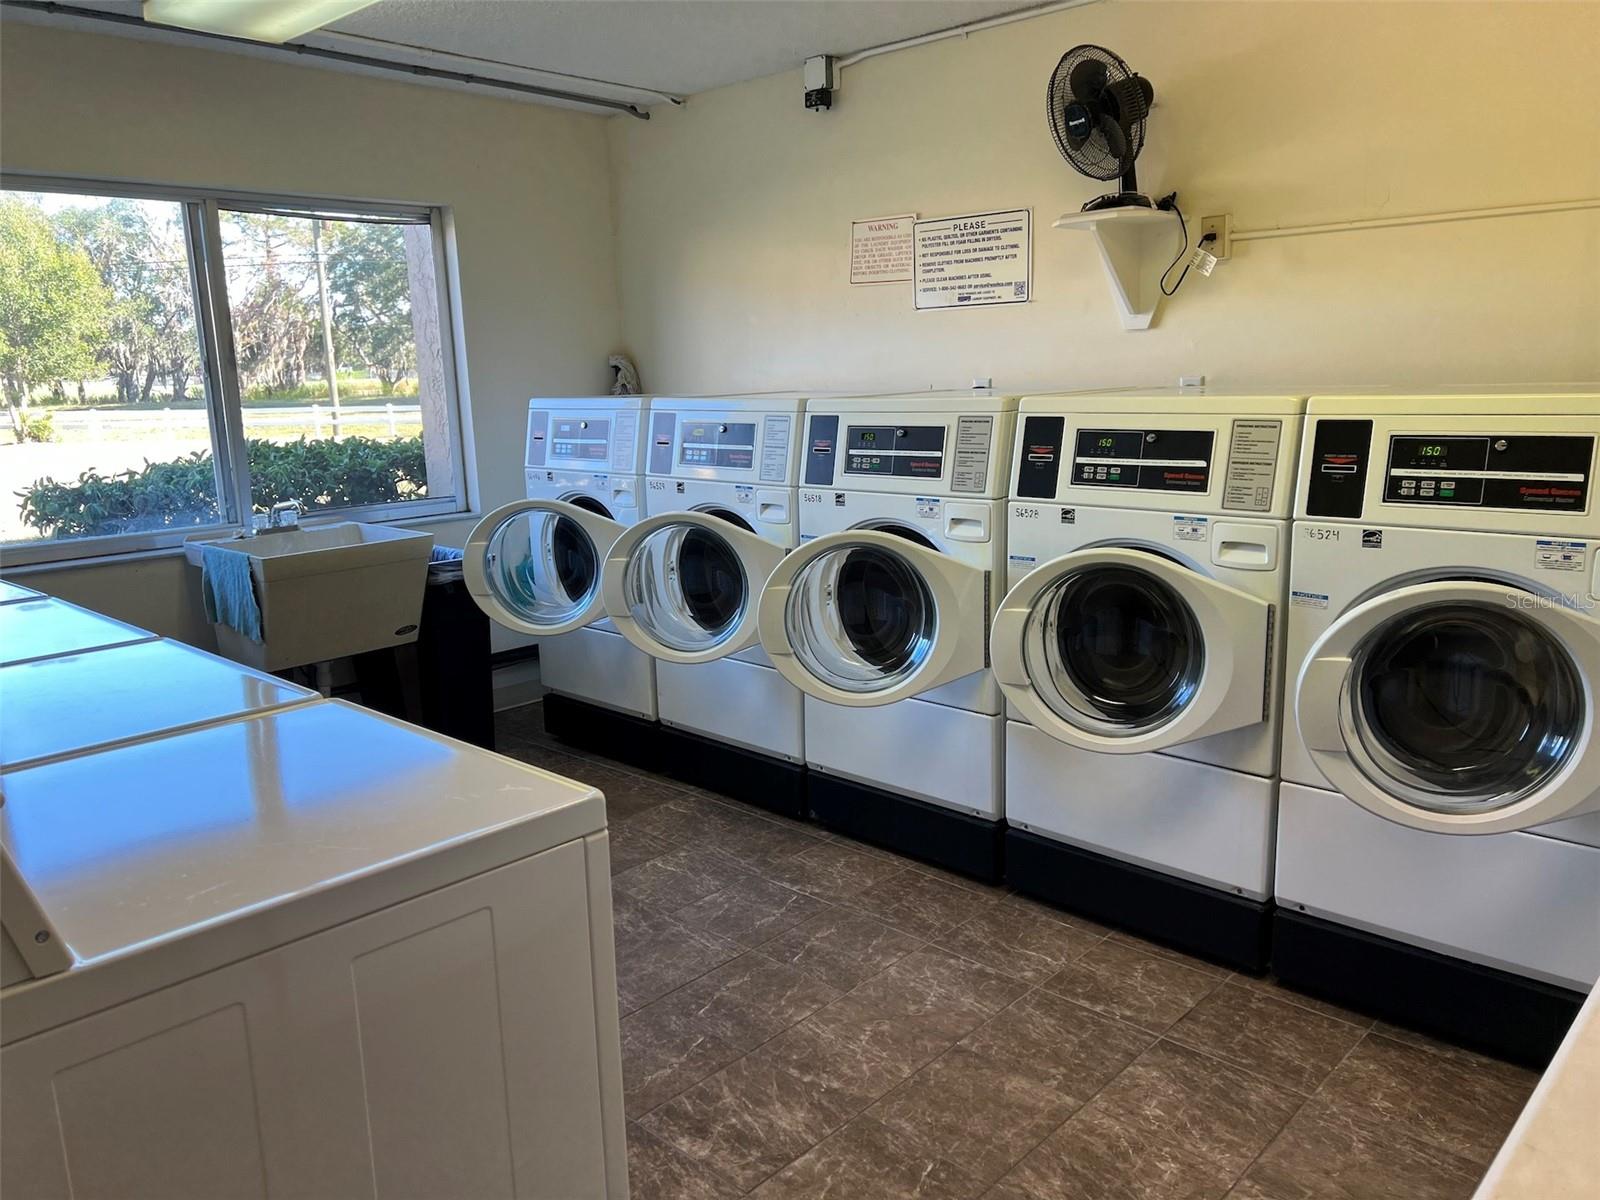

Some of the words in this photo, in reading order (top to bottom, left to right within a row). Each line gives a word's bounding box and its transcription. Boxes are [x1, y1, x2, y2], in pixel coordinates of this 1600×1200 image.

[868, 223, 898, 232] WARNING
[953, 220, 986, 232] PLEASE
[1098, 438, 1112, 446] 150
[1422, 446, 1440, 456] 150
[1520, 487, 1549, 495] Speed
[1550, 488, 1581, 496] Queen
[1016, 508, 1038, 518] 56528
